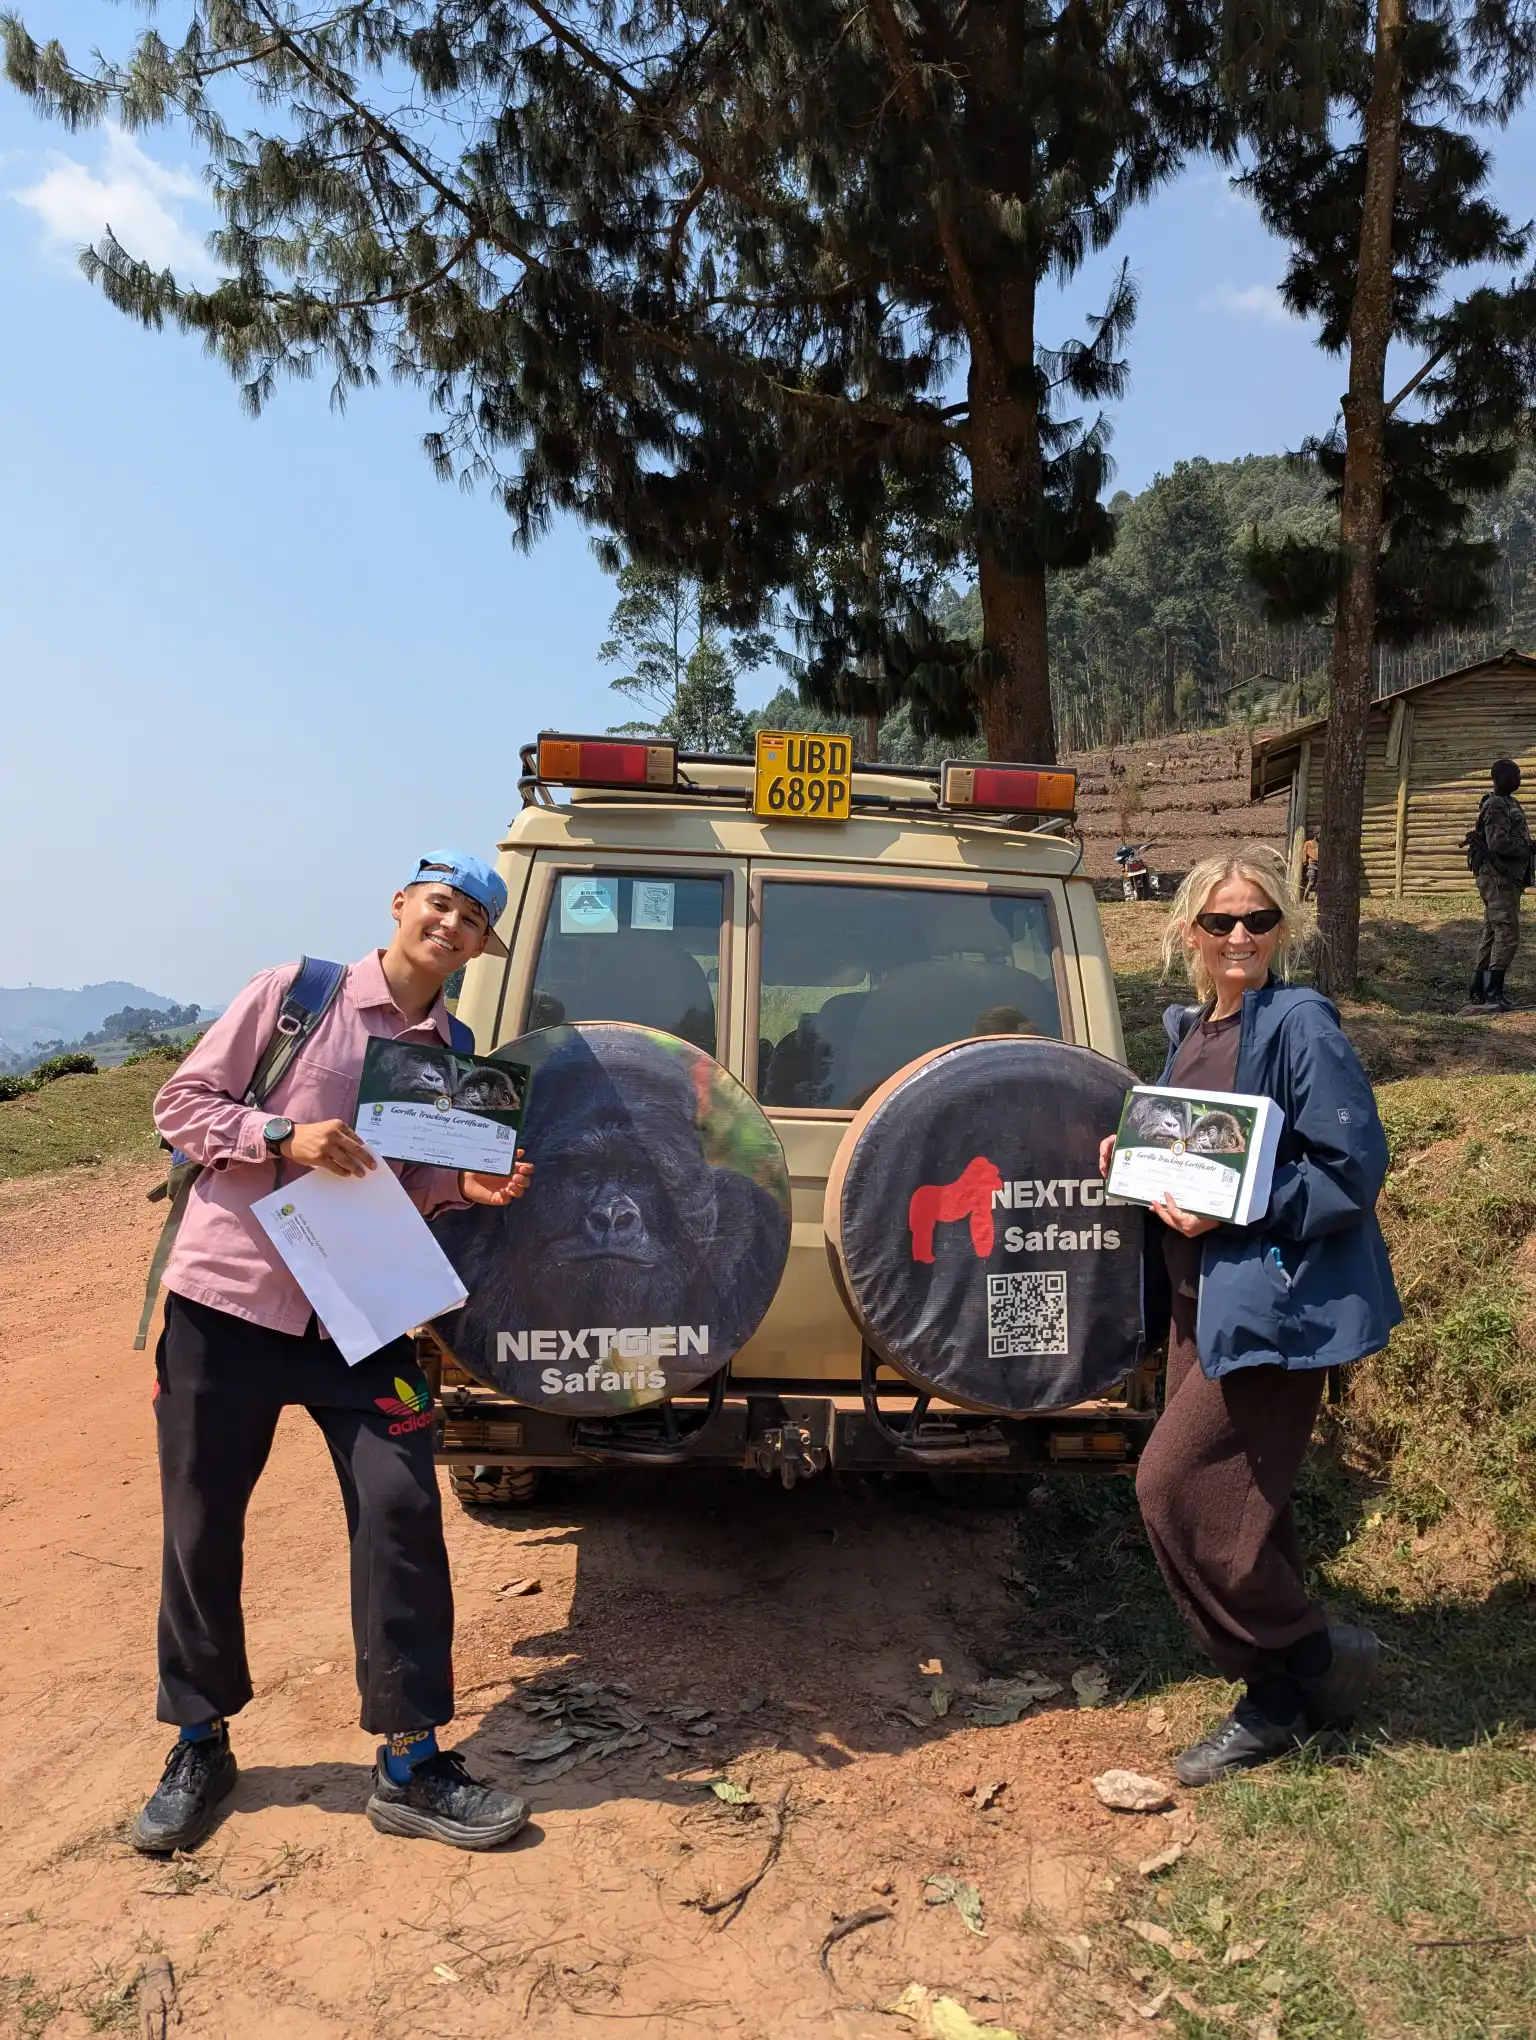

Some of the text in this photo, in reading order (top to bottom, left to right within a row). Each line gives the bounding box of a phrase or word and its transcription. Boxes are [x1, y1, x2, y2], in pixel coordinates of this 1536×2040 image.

[786, 739, 847, 775] UBD
[768, 776, 846, 814] 689P
[390, 1106, 416, 1117] Gorilla
[419, 1110, 451, 1124] Tracking
[452, 1116, 490, 1129] Certificate
[1137, 1151, 1217, 1172] Gorilla Tracking Certificate
[992, 1179, 1138, 1209] NEXTG
[1004, 1224, 1121, 1252] Safaris
[496, 1325, 709, 1363] NEXTGEN
[540, 1363, 667, 1395] Safaris
